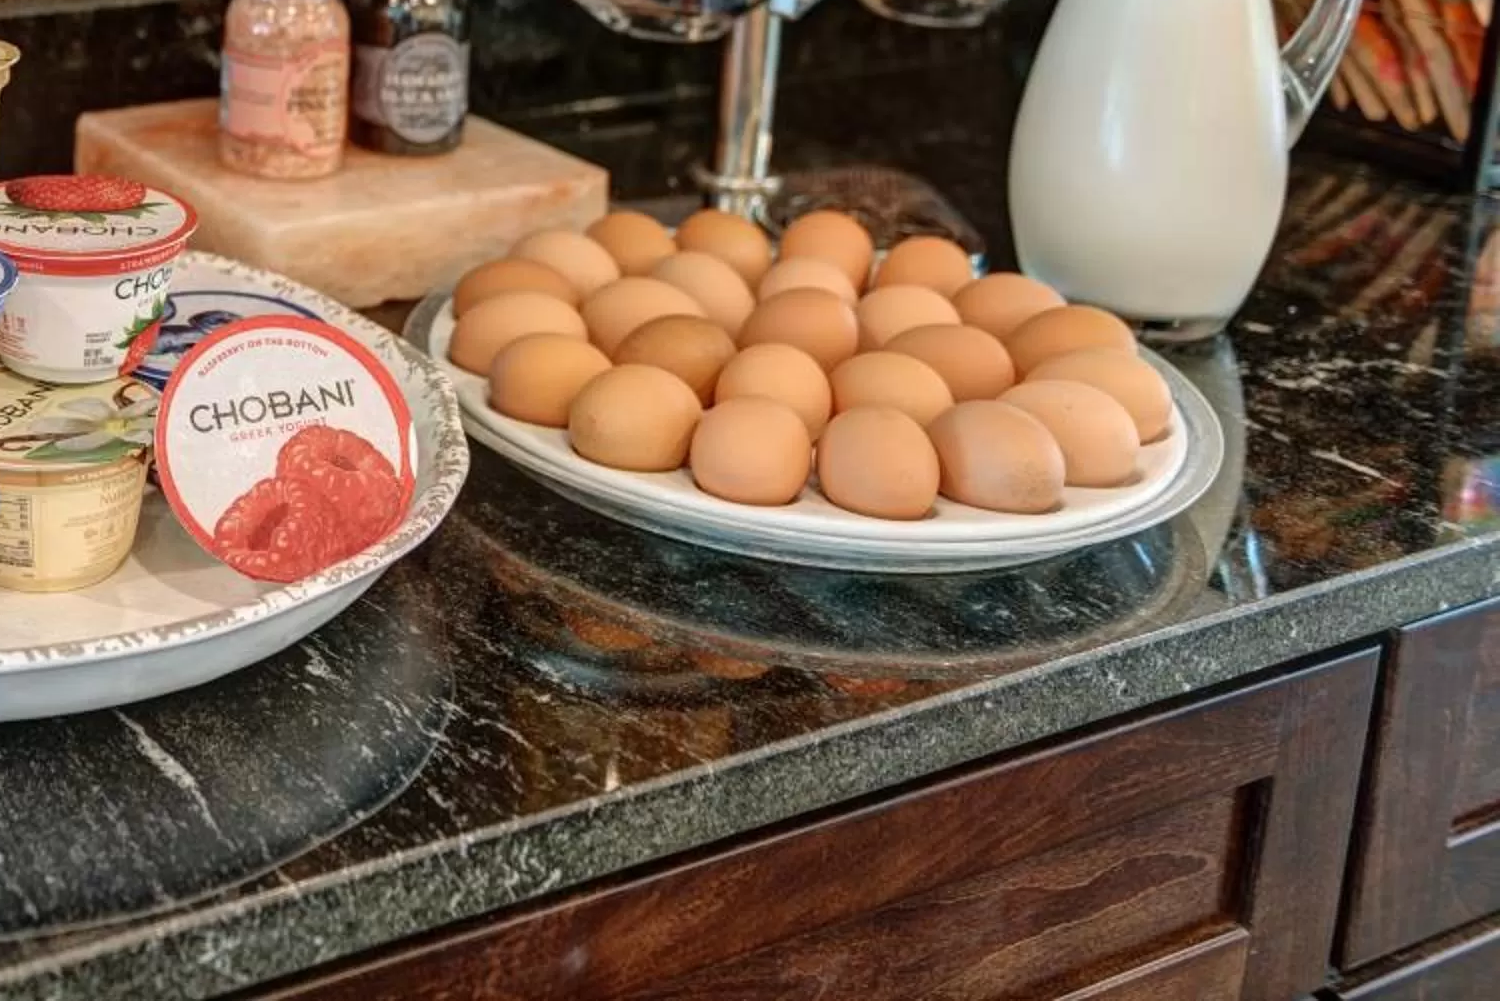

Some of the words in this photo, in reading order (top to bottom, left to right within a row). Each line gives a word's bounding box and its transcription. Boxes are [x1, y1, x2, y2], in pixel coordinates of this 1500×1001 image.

[247, 338, 263, 348] ON
[265, 337, 284, 346] THE
[286, 338, 329, 358] BOTTOM
[189, 378, 356, 433] CHOBANI
[229, 425, 274, 442] GREEK
